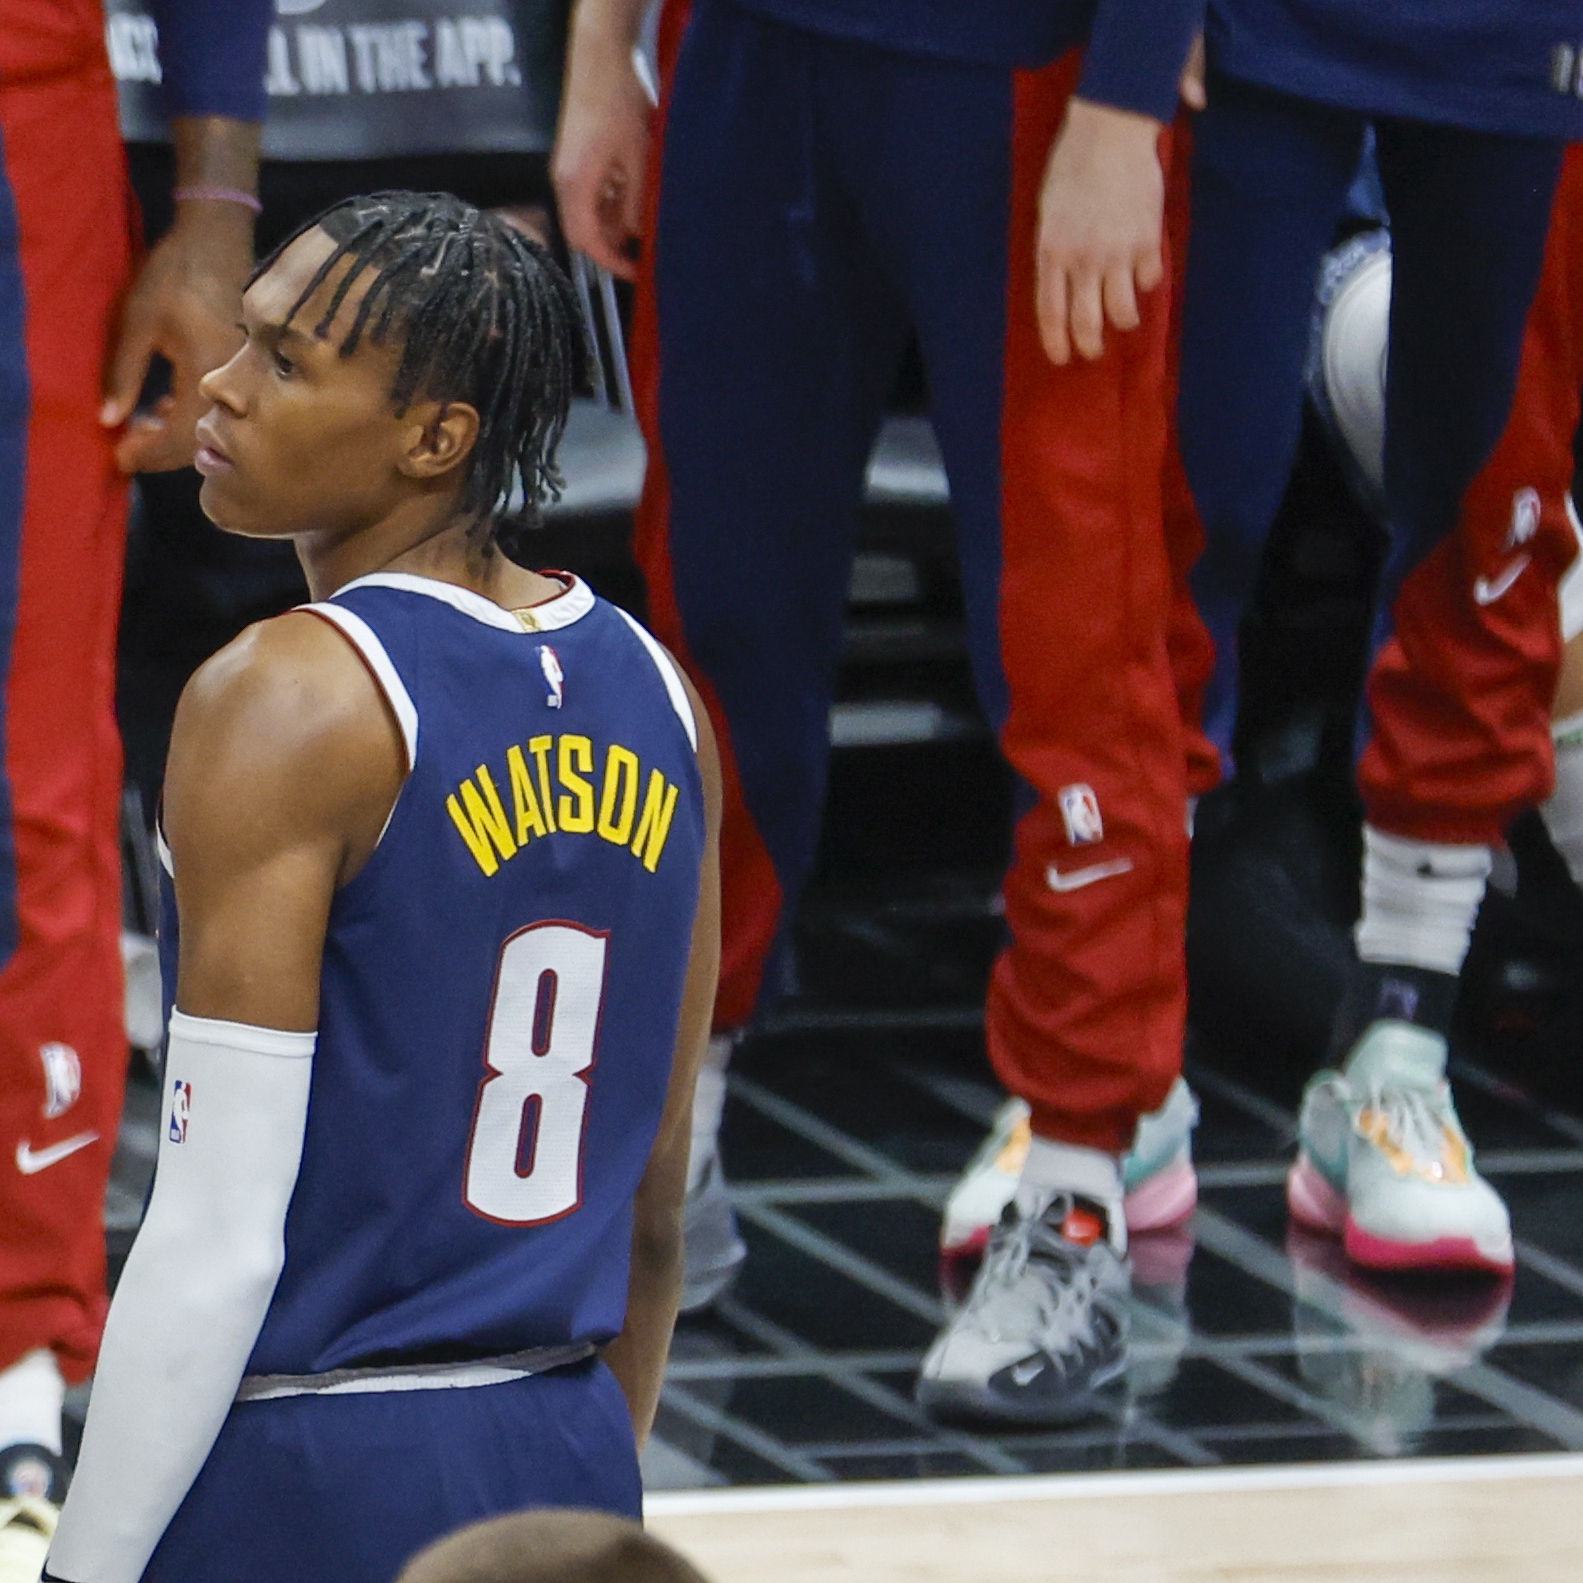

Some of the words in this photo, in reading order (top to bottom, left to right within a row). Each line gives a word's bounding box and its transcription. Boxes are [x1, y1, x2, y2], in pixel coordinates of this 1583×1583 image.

[297, 24, 350, 94] IN
[350, 21, 434, 92] THE
[446, 733, 679, 877] WATSON
[462, 918, 612, 1228] 8
